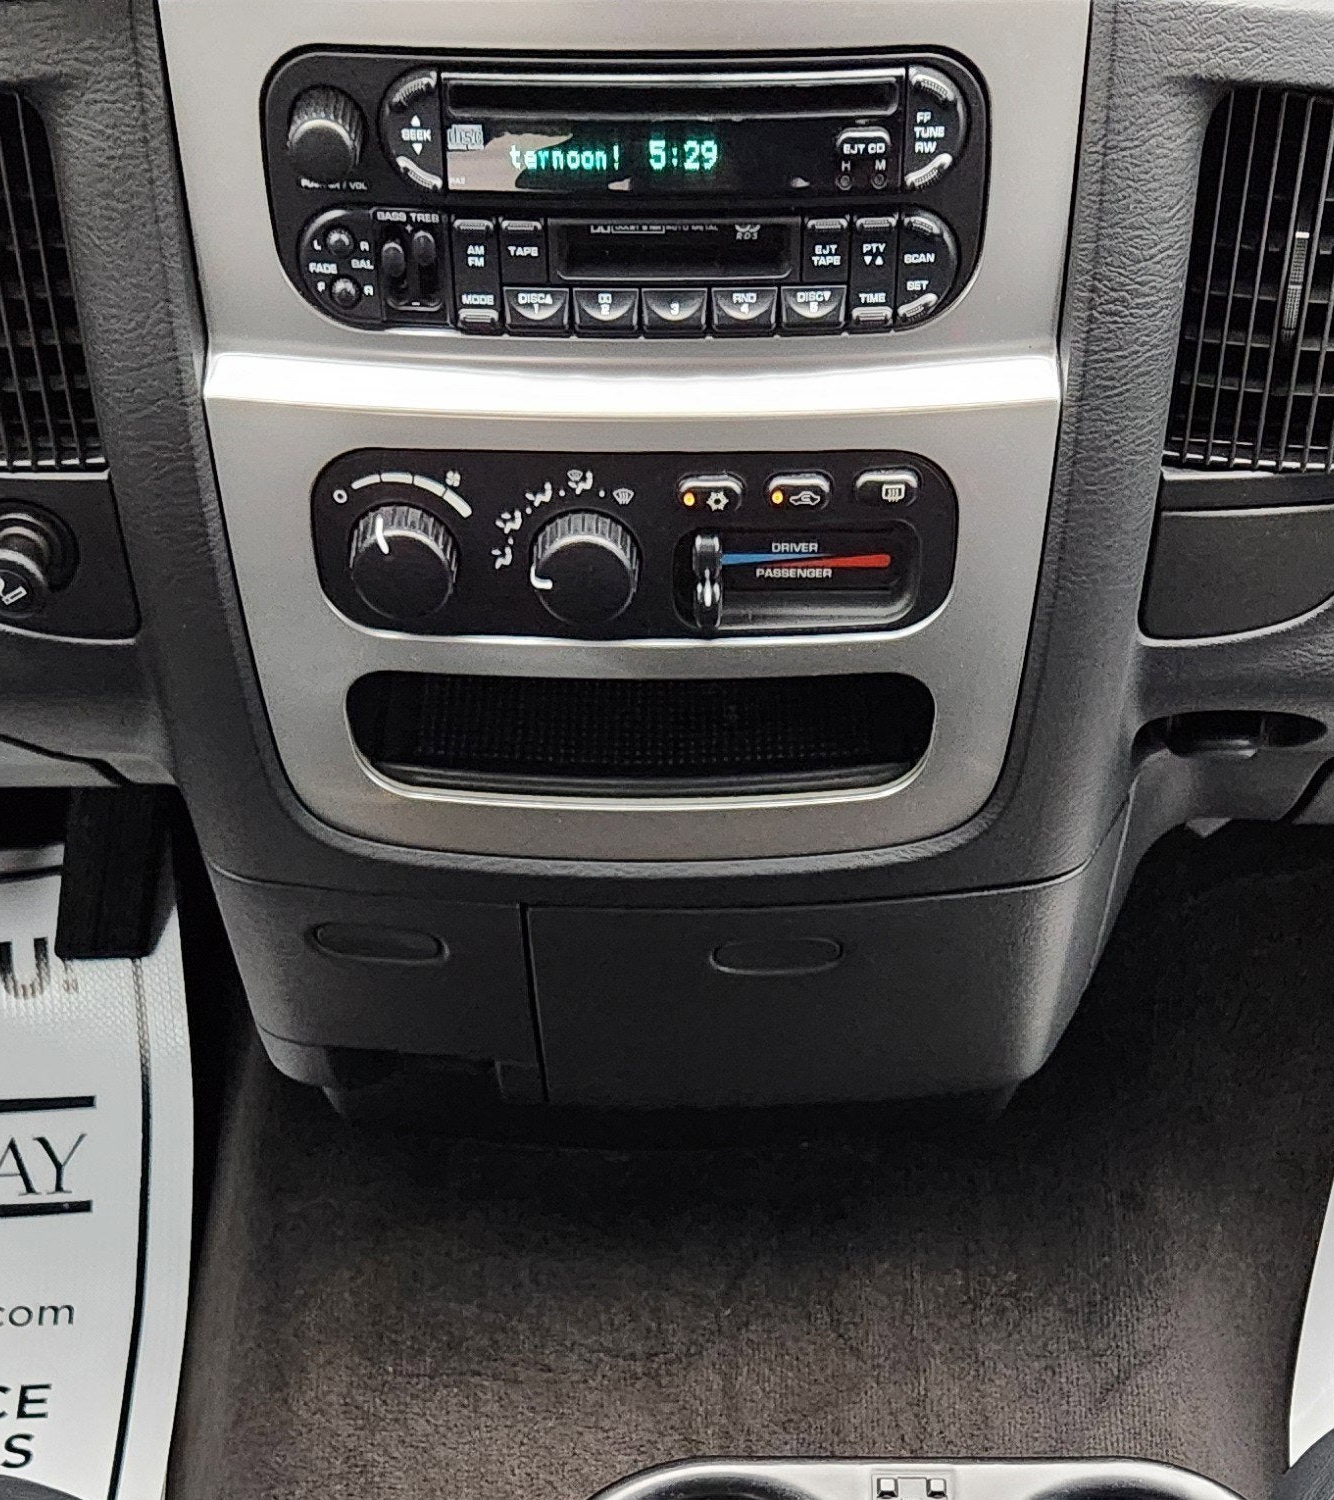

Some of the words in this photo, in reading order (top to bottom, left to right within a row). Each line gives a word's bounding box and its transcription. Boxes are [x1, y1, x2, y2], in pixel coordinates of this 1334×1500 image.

[401, 129, 432, 142] SEEK
[914, 126, 945, 138] TUNE
[843, 143, 866, 154] EJT
[867, 143, 886, 154] CD
[509, 144, 620, 171] ternoon!
[649, 140, 719, 171] 5:29
[874, 159, 887, 171] M
[376, 211, 407, 222] BASS
[409, 213, 440, 223] TREB
[467, 244, 485, 256] AM
[507, 246, 539, 257] TAPE
[814, 244, 838, 255] EJT
[862, 243, 886, 254] PTY
[467, 256, 485, 267] FM
[811, 255, 842, 266] TAPE
[903, 252, 936, 264] SCAN
[308, 262, 338, 274] FADE
[350, 258, 374, 270] BAL
[461, 294, 495, 305] MODE
[732, 292, 757, 303] RND
[858, 293, 887, 304] TIME
[669, 301, 680, 315] 3
[771, 542, 819, 553] DRIVER
[755, 568, 833, 579] PASSENGER
